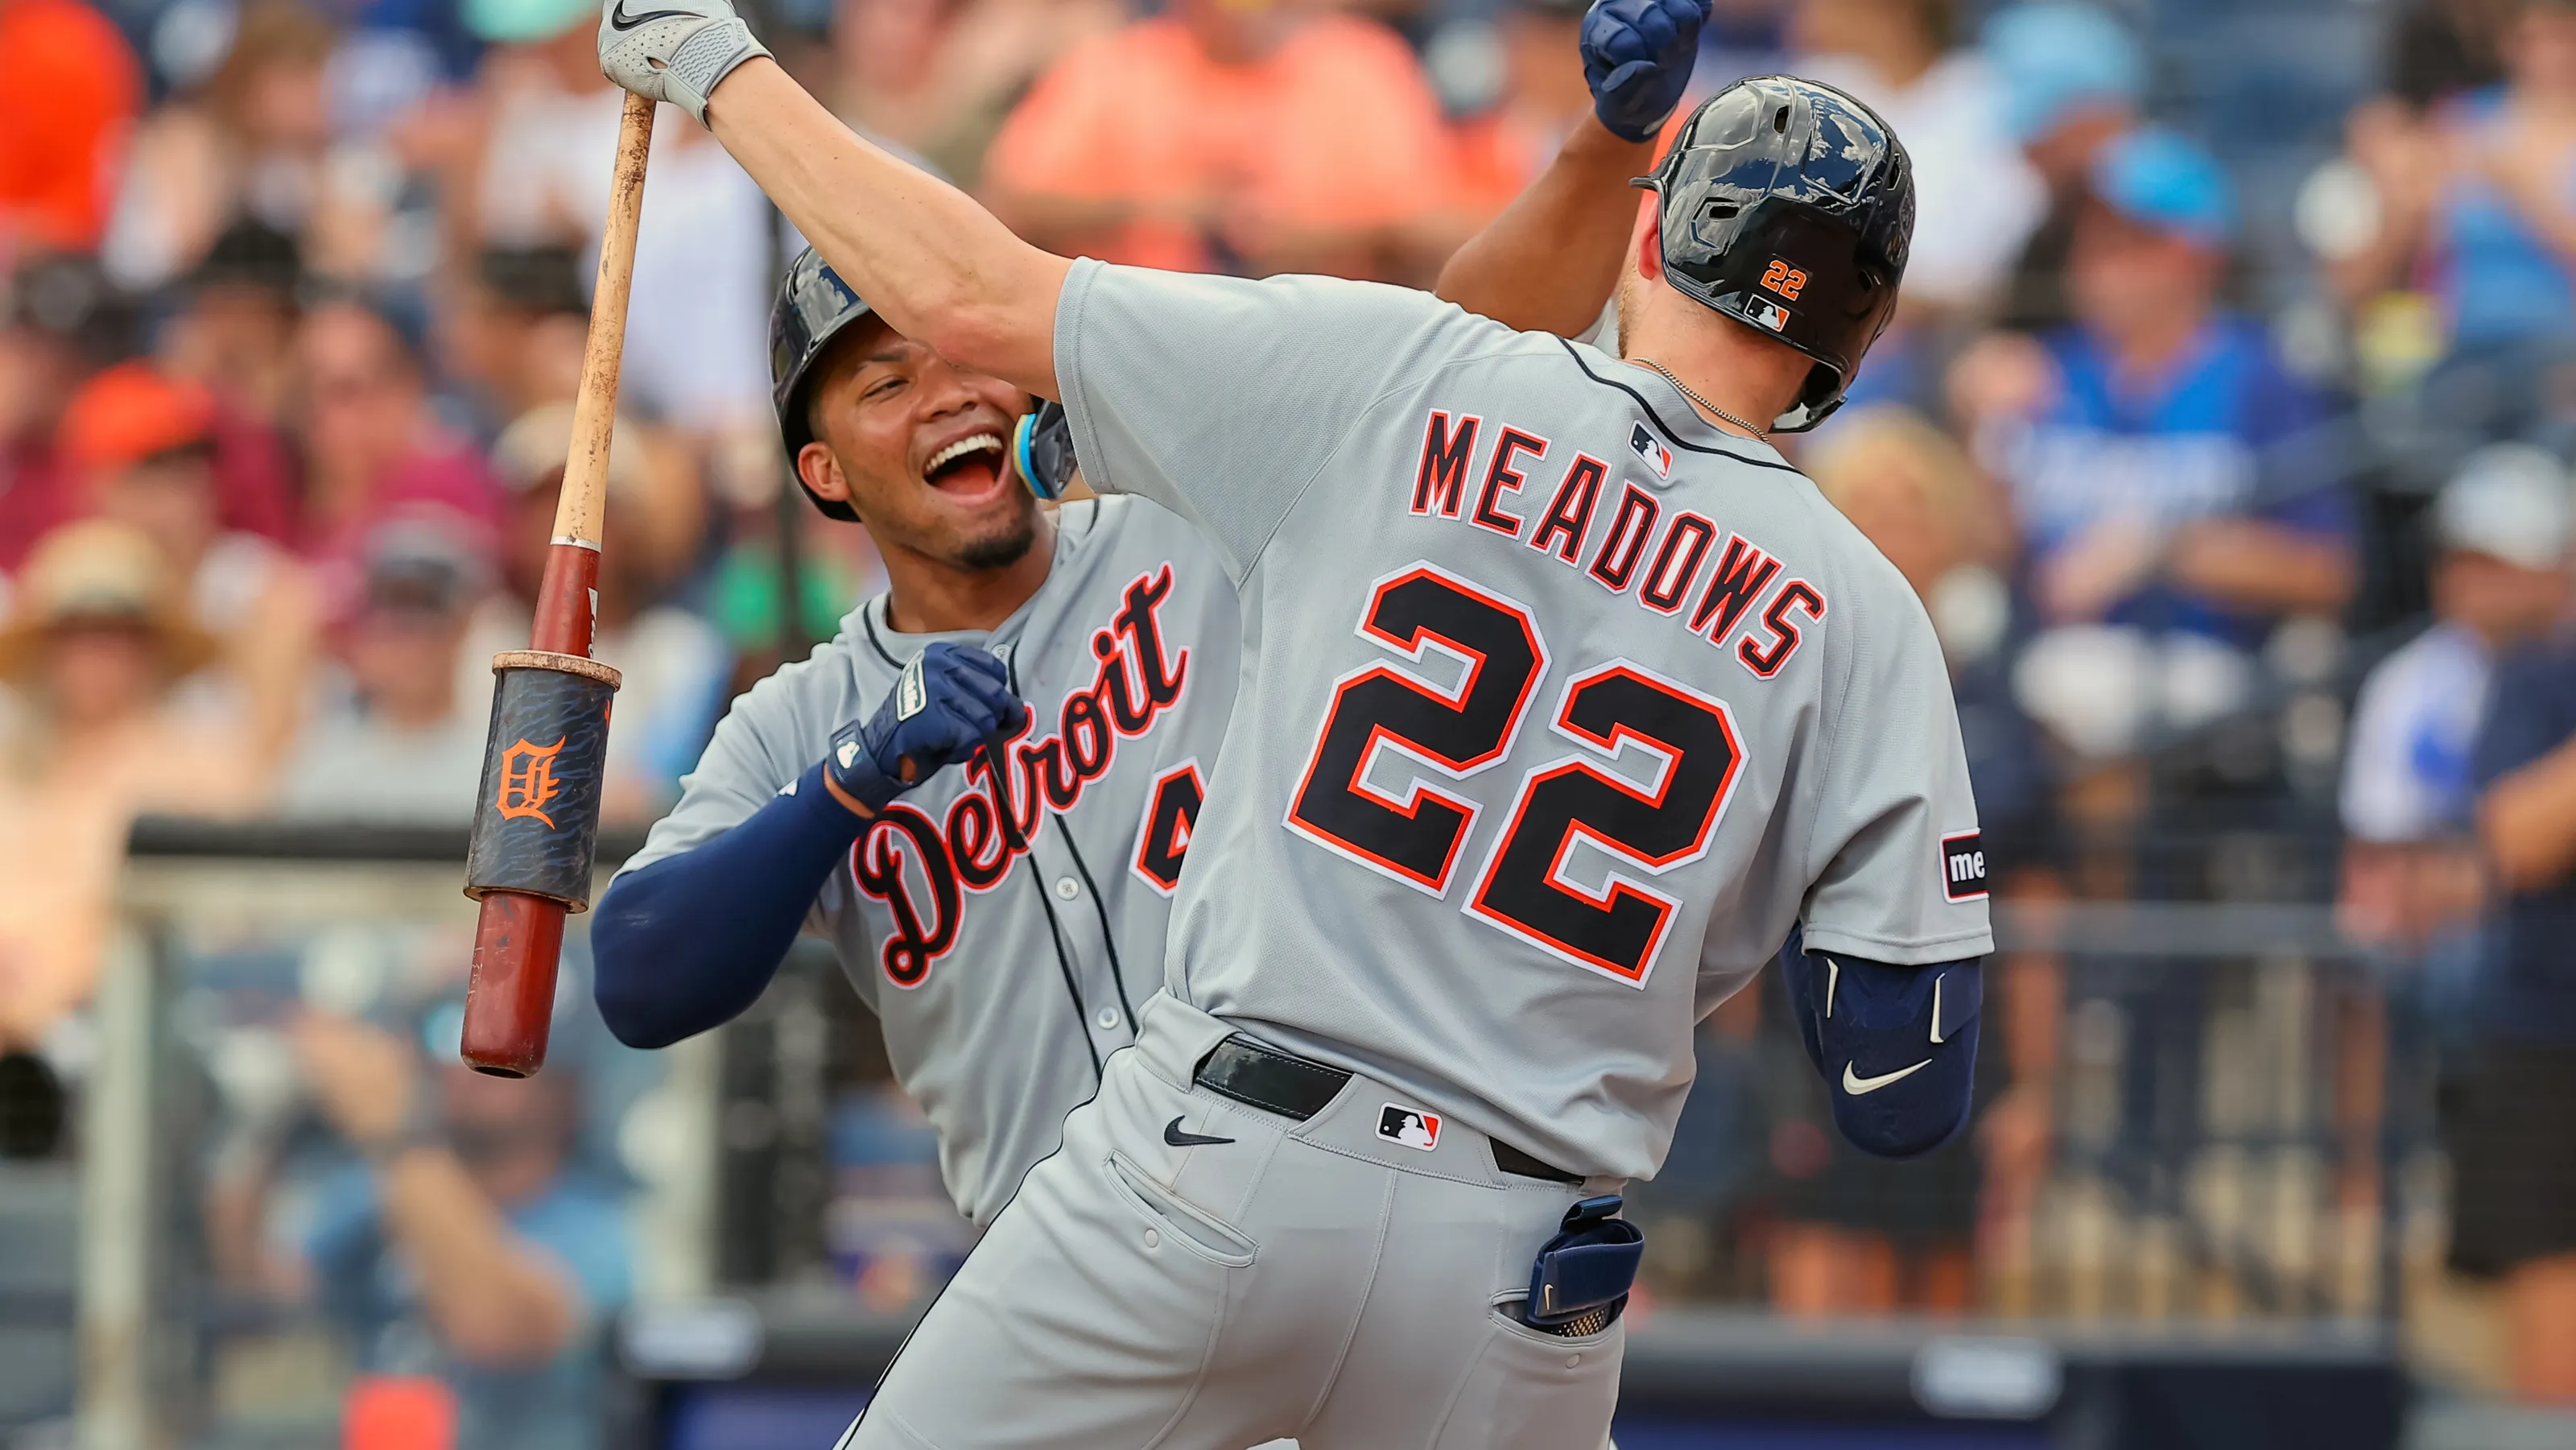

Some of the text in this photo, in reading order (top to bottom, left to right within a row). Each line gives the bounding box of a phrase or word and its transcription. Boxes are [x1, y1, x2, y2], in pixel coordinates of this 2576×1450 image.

[1760, 259, 1807, 302] 22
[1409, 409, 1828, 680] MEADOWS
[848, 560, 1191, 989] Detroit
[1282, 560, 1750, 990] 22
[1949, 851, 1986, 882] me
